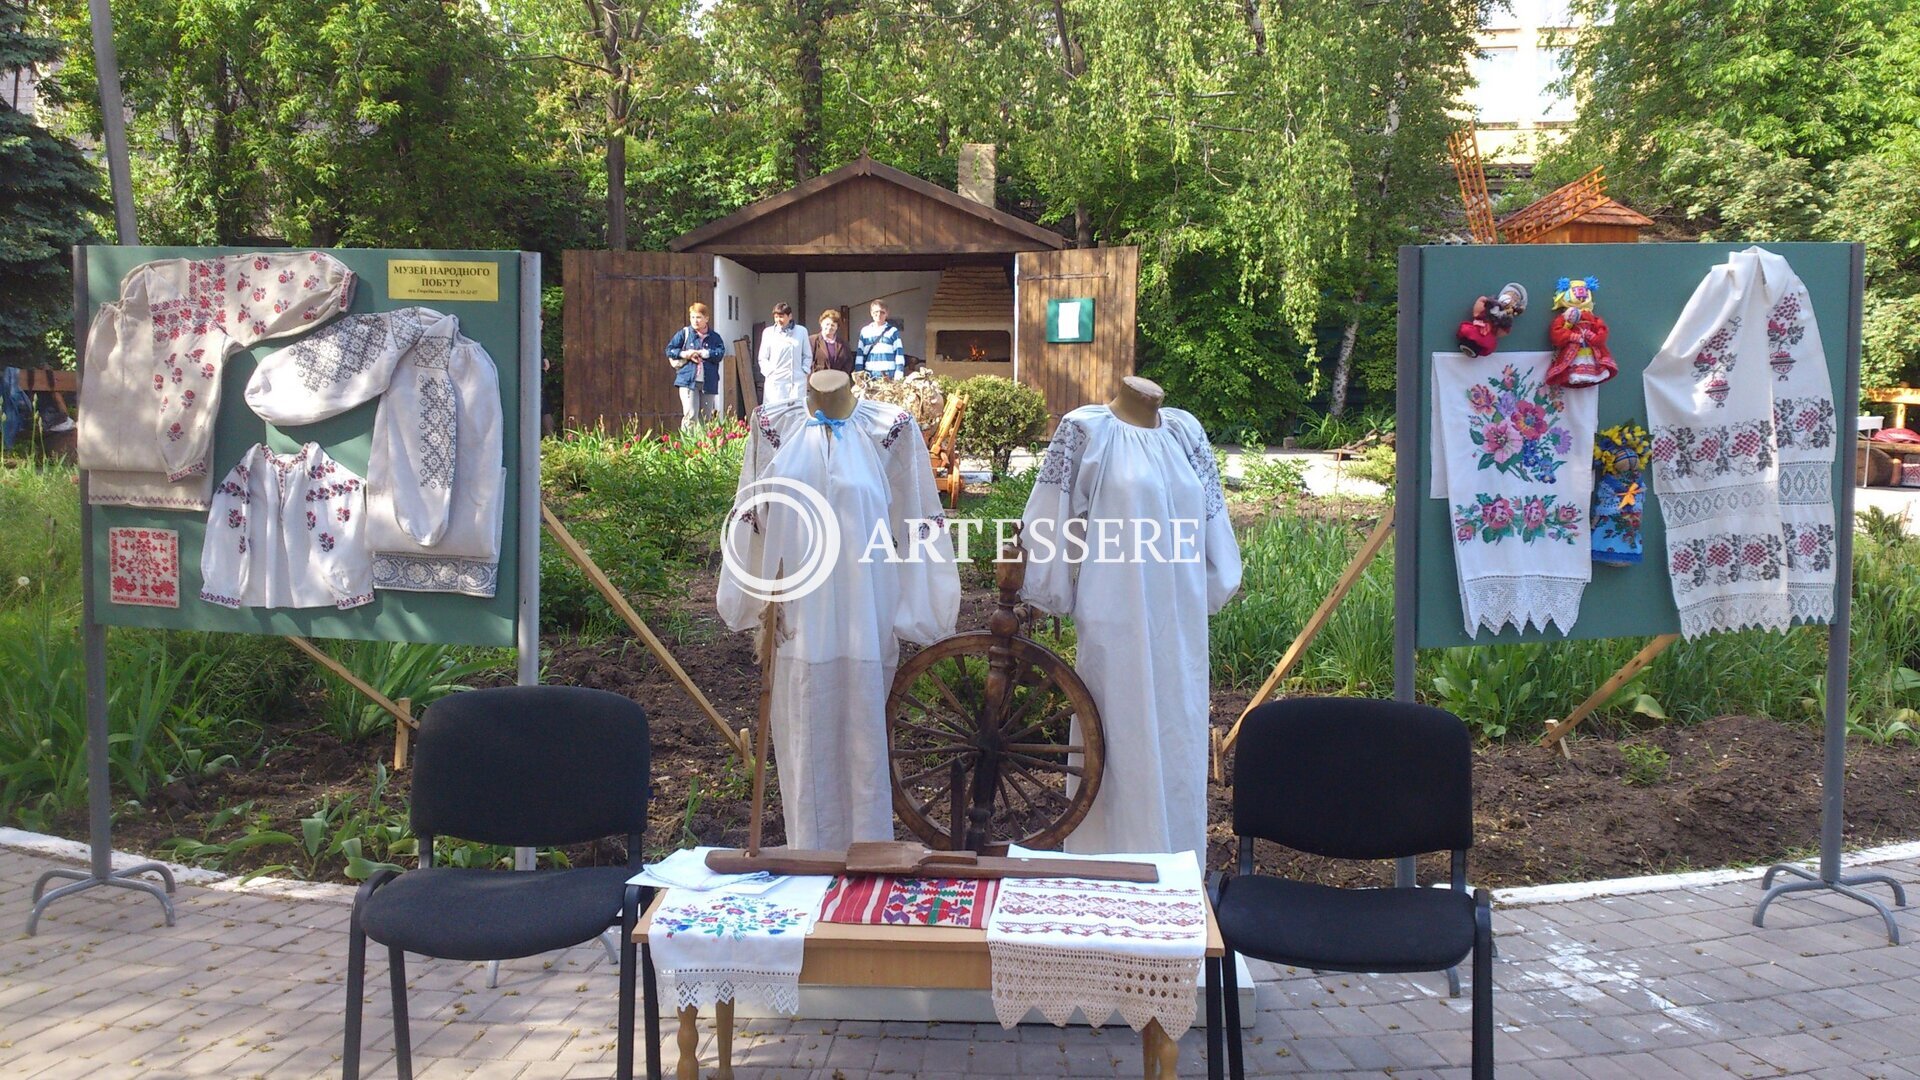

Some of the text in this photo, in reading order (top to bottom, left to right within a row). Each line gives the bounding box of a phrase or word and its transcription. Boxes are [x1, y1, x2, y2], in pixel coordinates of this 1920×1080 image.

[393, 264, 490, 277] МУЗЕЙ НАРОДНОГО
[421, 278, 462, 287] ПОБУТУ
